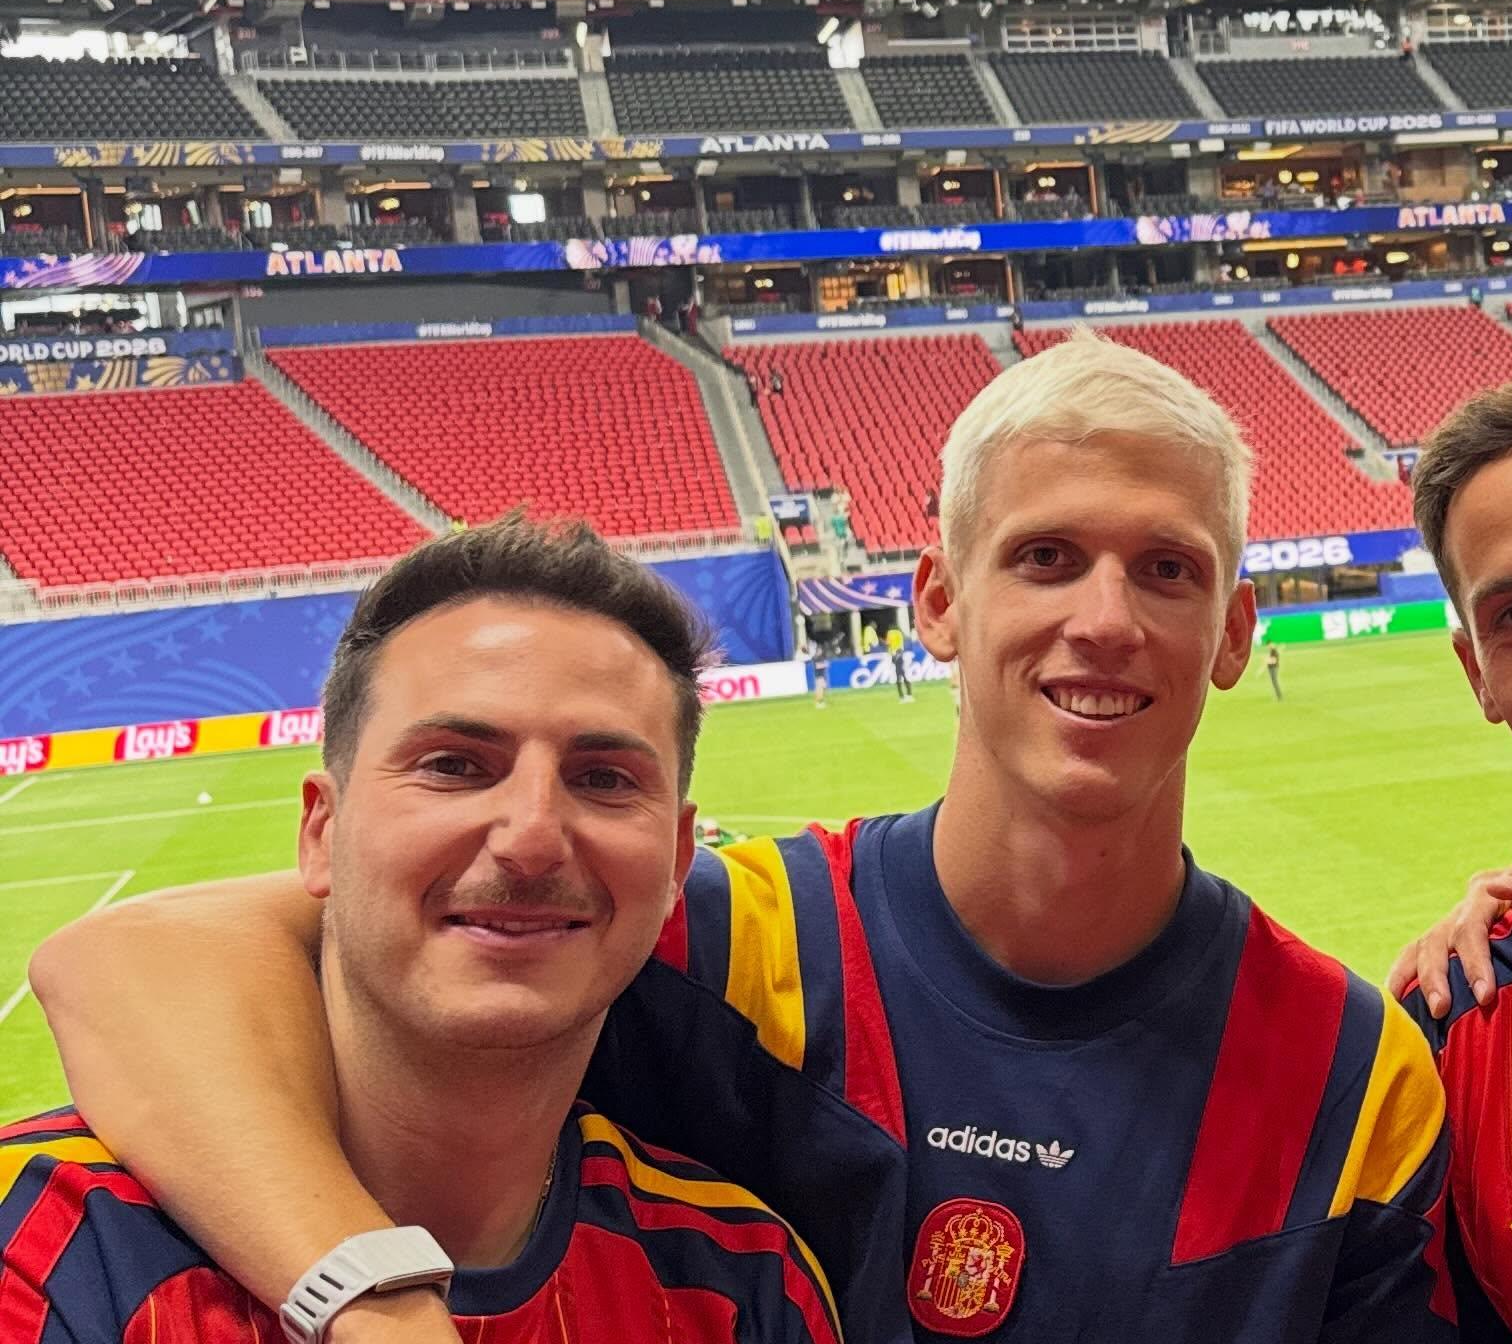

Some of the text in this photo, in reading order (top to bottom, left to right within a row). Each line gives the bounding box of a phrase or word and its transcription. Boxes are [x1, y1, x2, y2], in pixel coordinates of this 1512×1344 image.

[1264, 119, 1299, 136] FIFA
[1299, 117, 1357, 135] WORLD
[1358, 115, 1389, 133] CUP
[1390, 113, 1443, 131] 2026
[700, 132, 830, 154] ATLANTA
[1397, 203, 1506, 229] ATLANTA
[266, 247, 403, 276] ATLANTA
[0, 337, 167, 362] RLD CUP 2026
[1244, 536, 1350, 573] 2026
[124, 720, 192, 761] Lay's
[269, 711, 322, 746] Lay
[927, 1125, 1031, 1163] adidas
